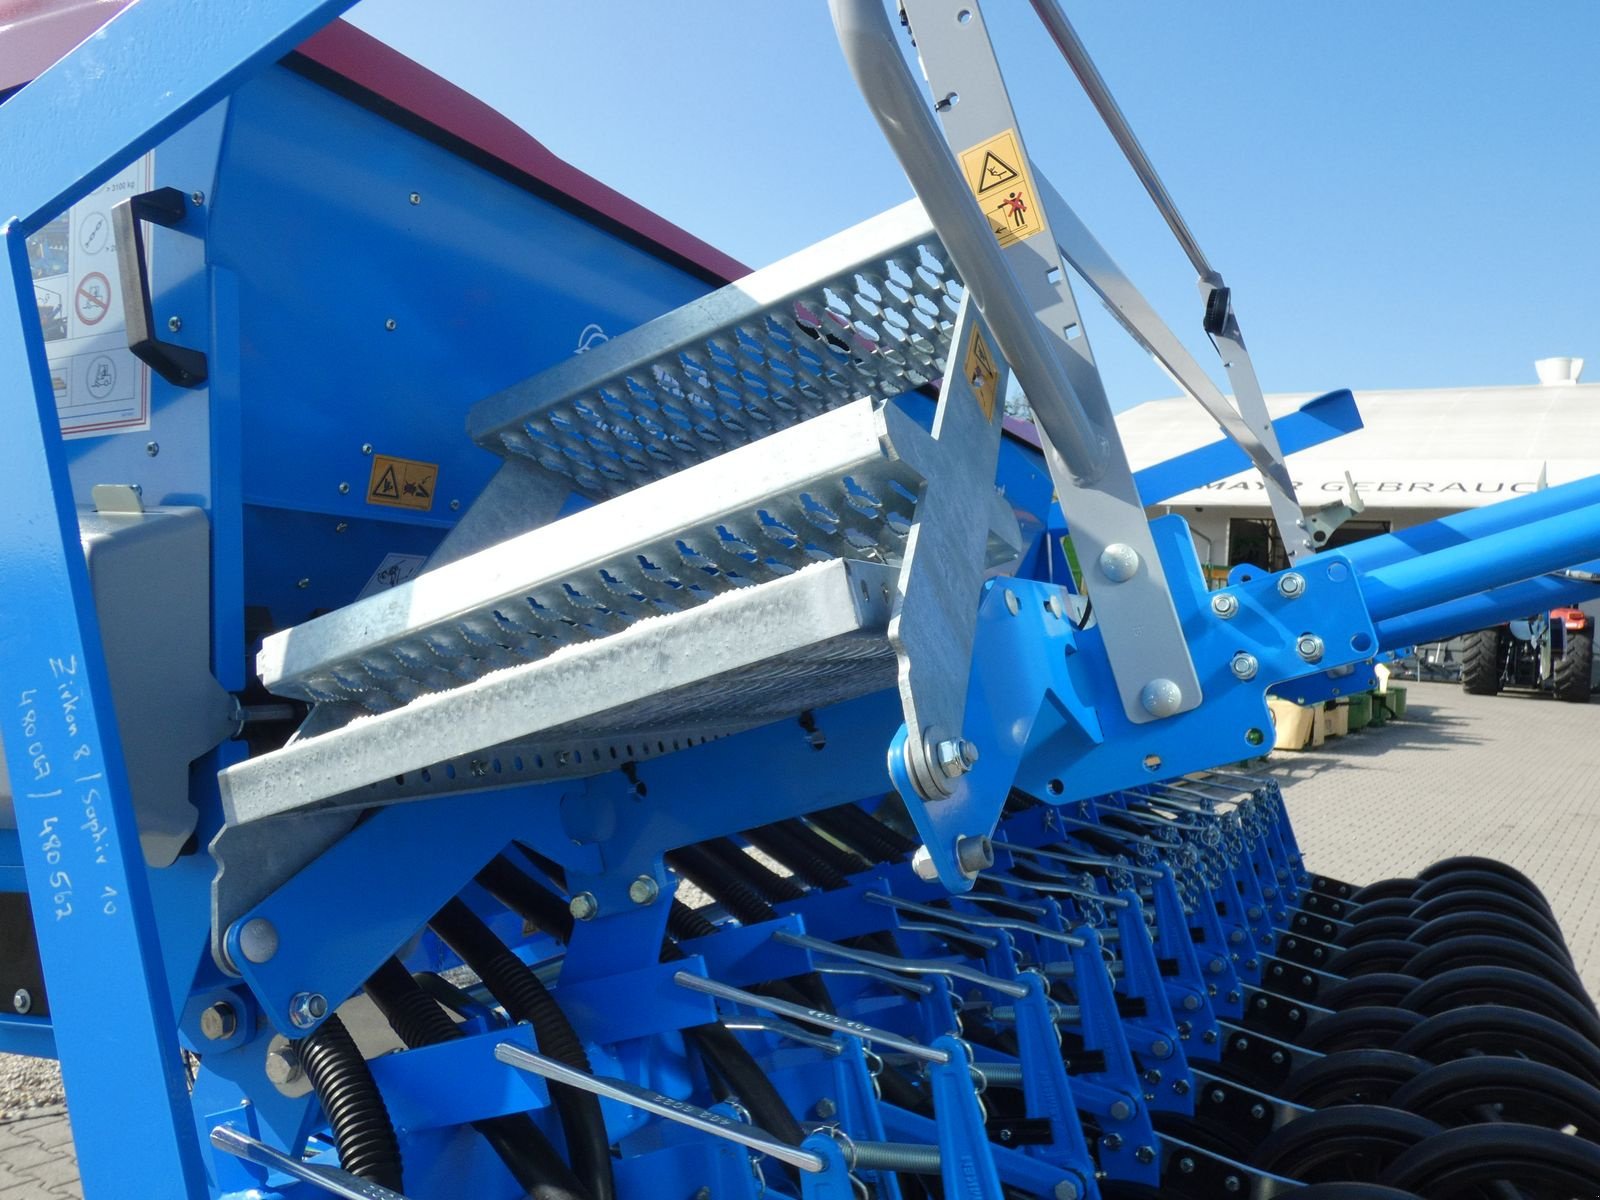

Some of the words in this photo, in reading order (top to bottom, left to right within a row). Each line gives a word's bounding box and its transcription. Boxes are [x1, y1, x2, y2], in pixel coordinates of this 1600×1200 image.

[1321, 481, 1549, 493] GEBRAUC
[73, 743, 91, 761] 8
[100, 885, 118, 915] 10
